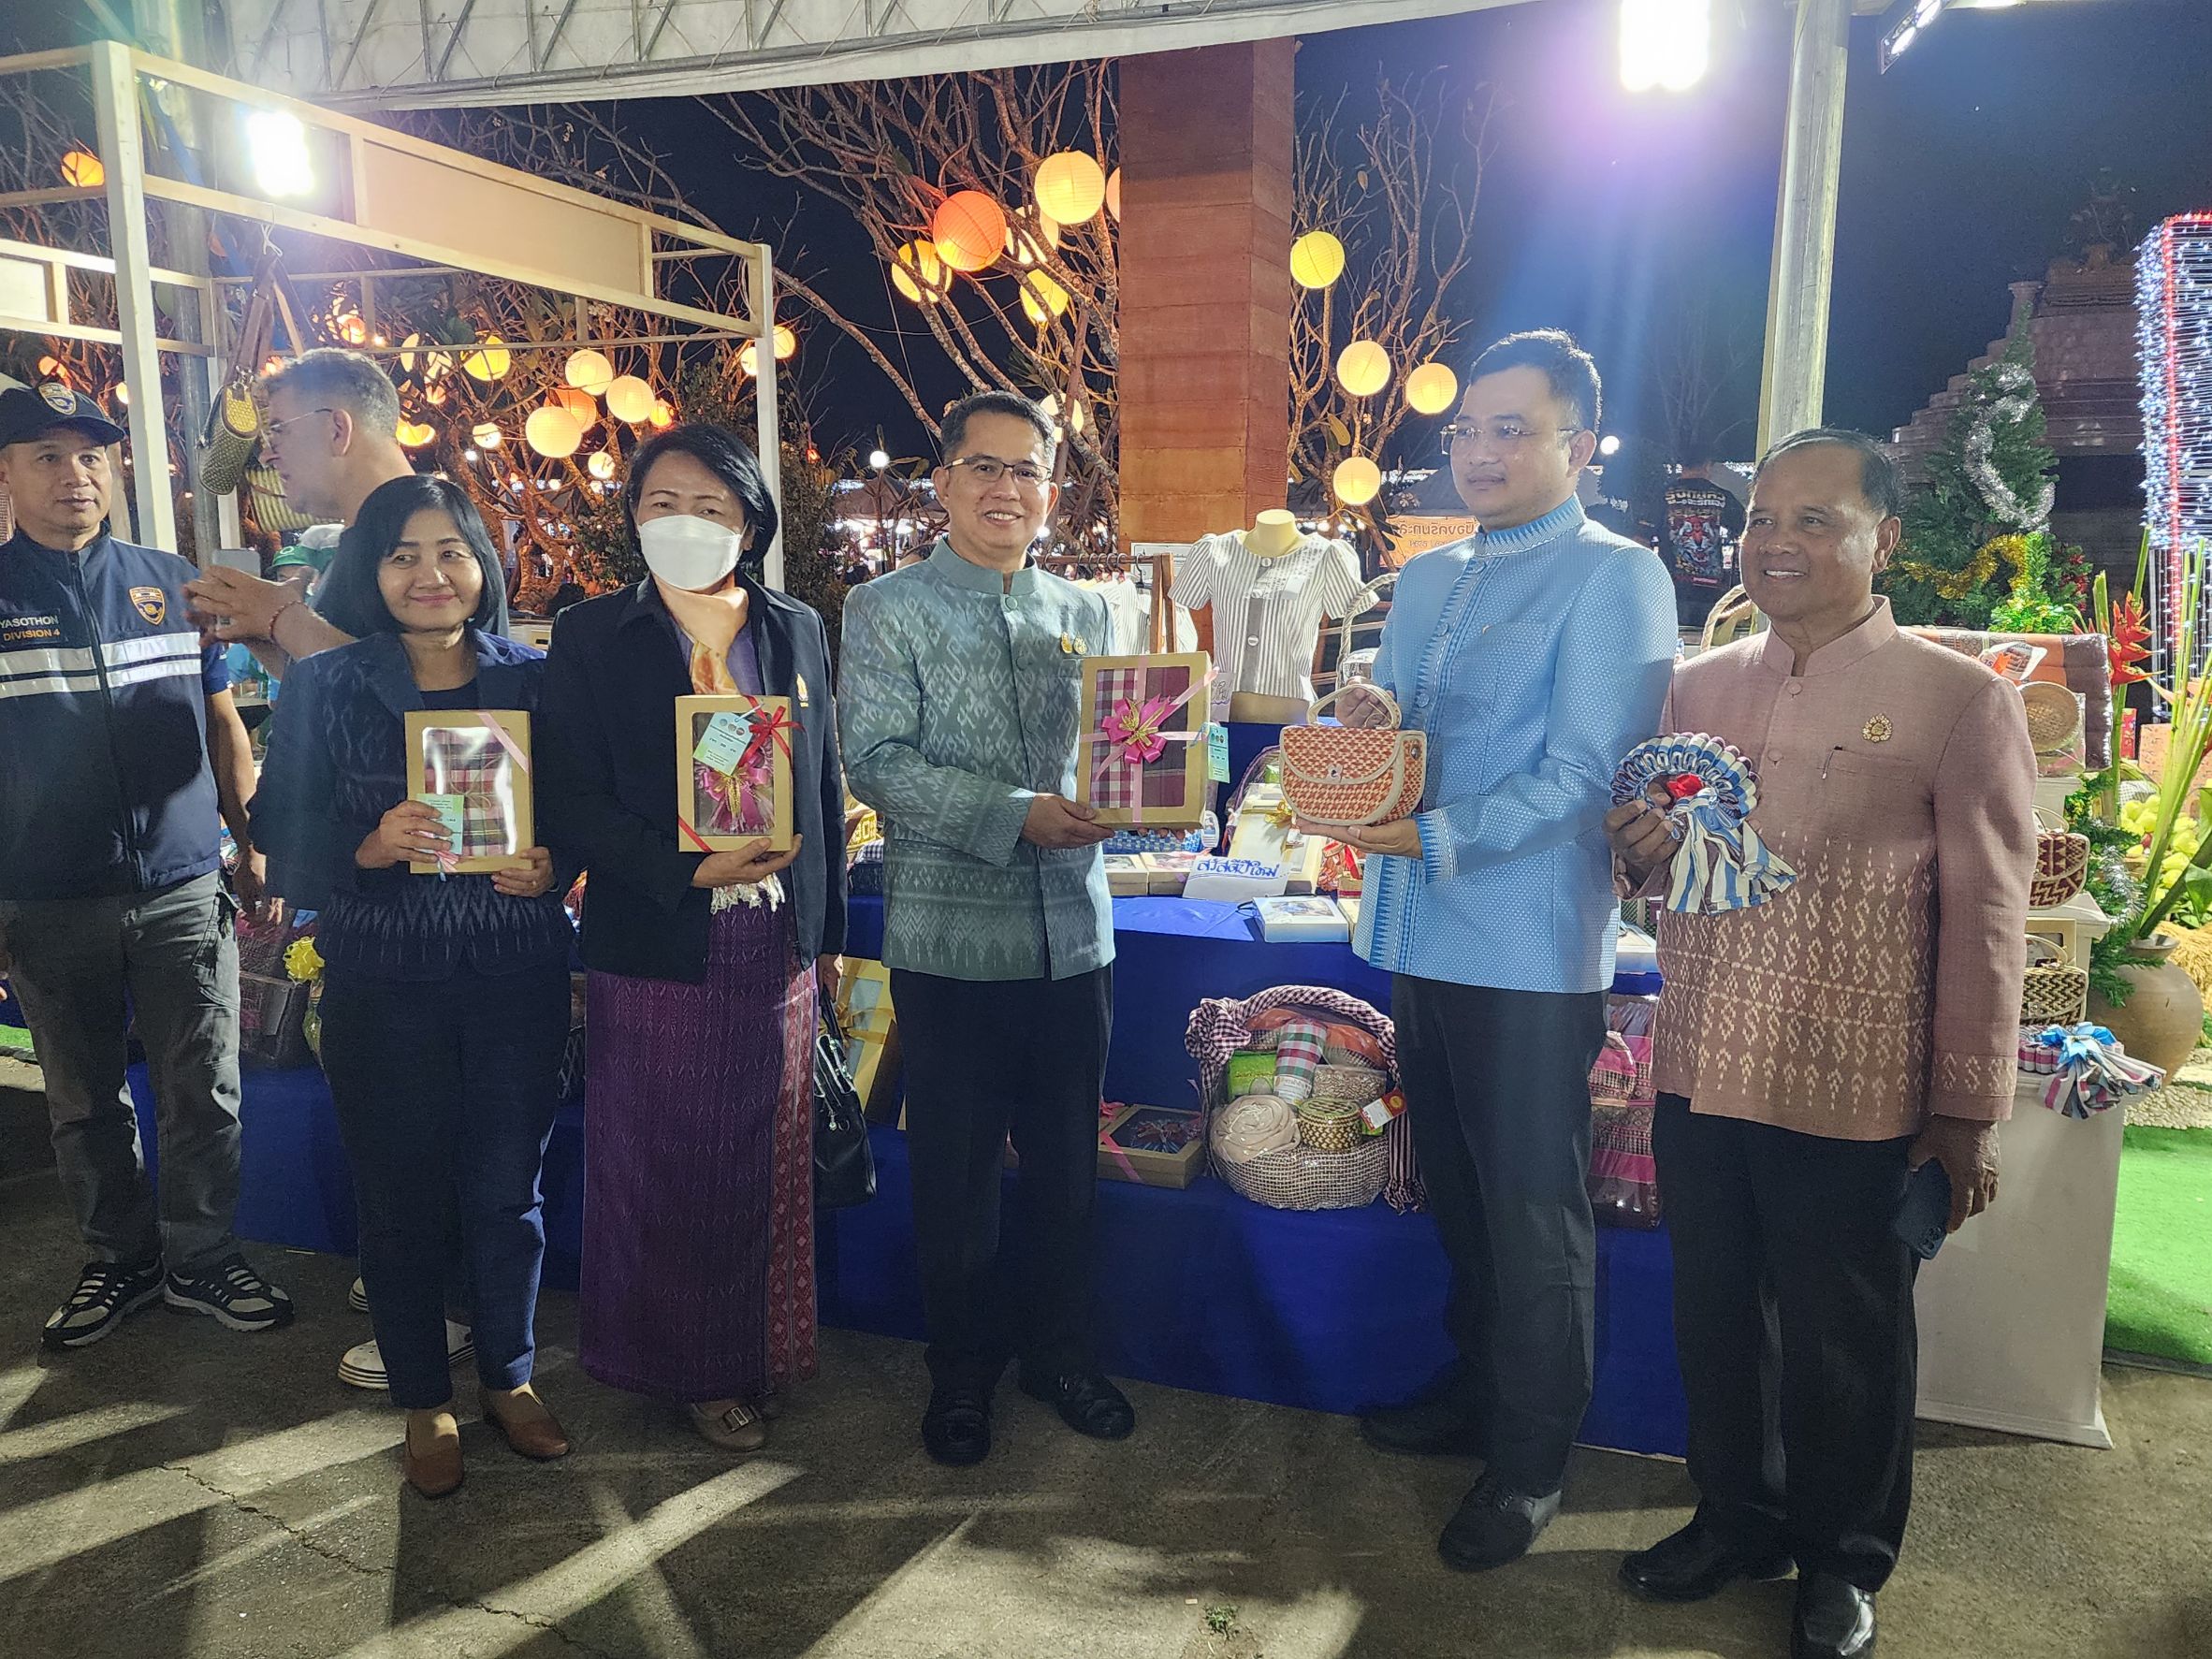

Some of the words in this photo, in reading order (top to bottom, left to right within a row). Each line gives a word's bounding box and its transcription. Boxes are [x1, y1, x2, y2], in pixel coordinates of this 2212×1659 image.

[0, 615, 59, 629] YASOTHON
[3, 630, 52, 642] DIVISION
[53, 628, 61, 636] 4
[1198, 858, 1280, 878] สวัสดีปีใหม่
